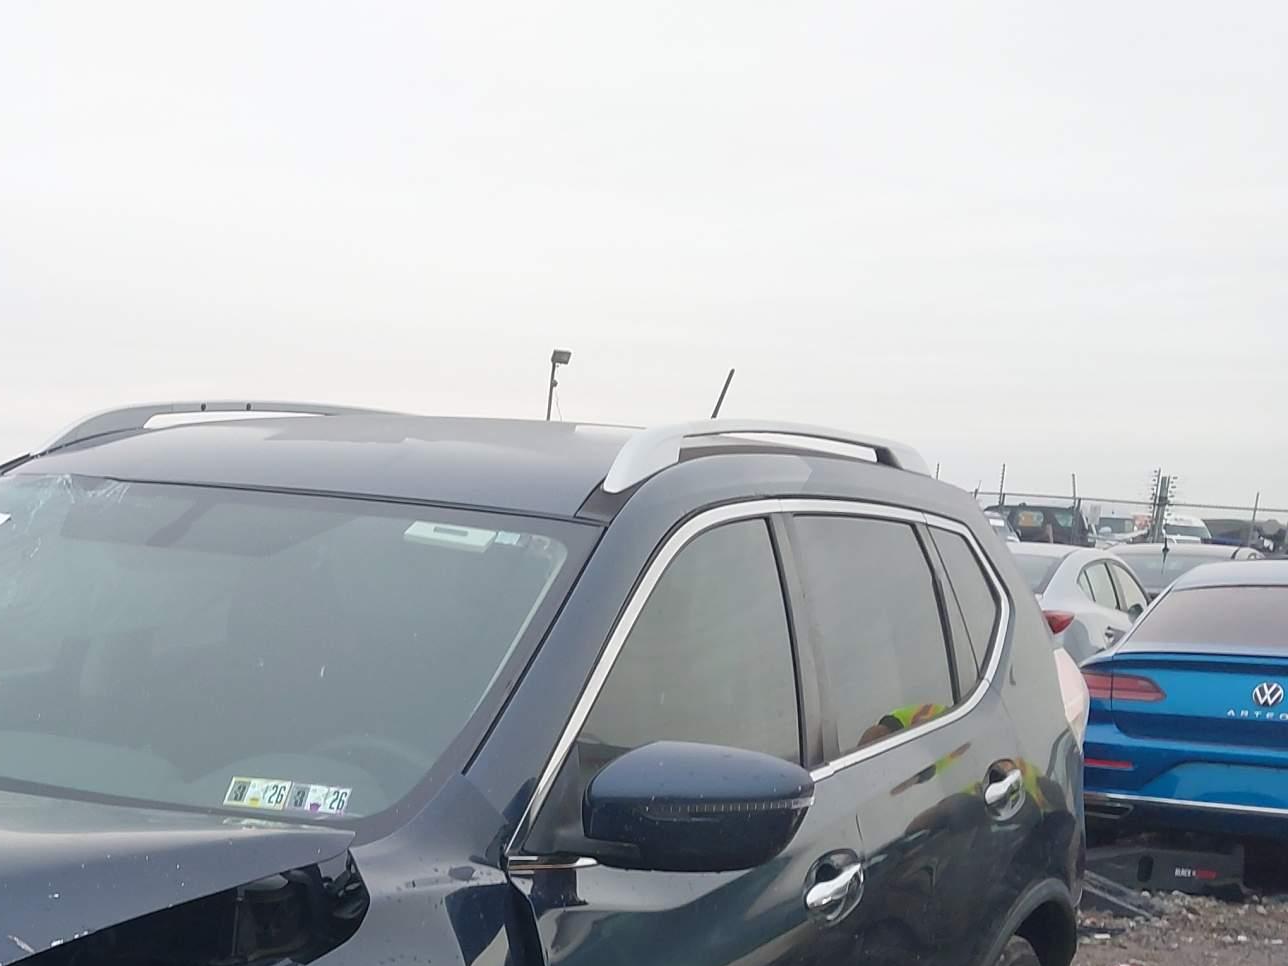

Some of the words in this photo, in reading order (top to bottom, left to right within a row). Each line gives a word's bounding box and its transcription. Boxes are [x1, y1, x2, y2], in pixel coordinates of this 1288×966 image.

[233, 784, 247, 802] 3
[267, 785, 287, 804] 26
[293, 789, 306, 808] 3
[328, 790, 348, 810] 26
